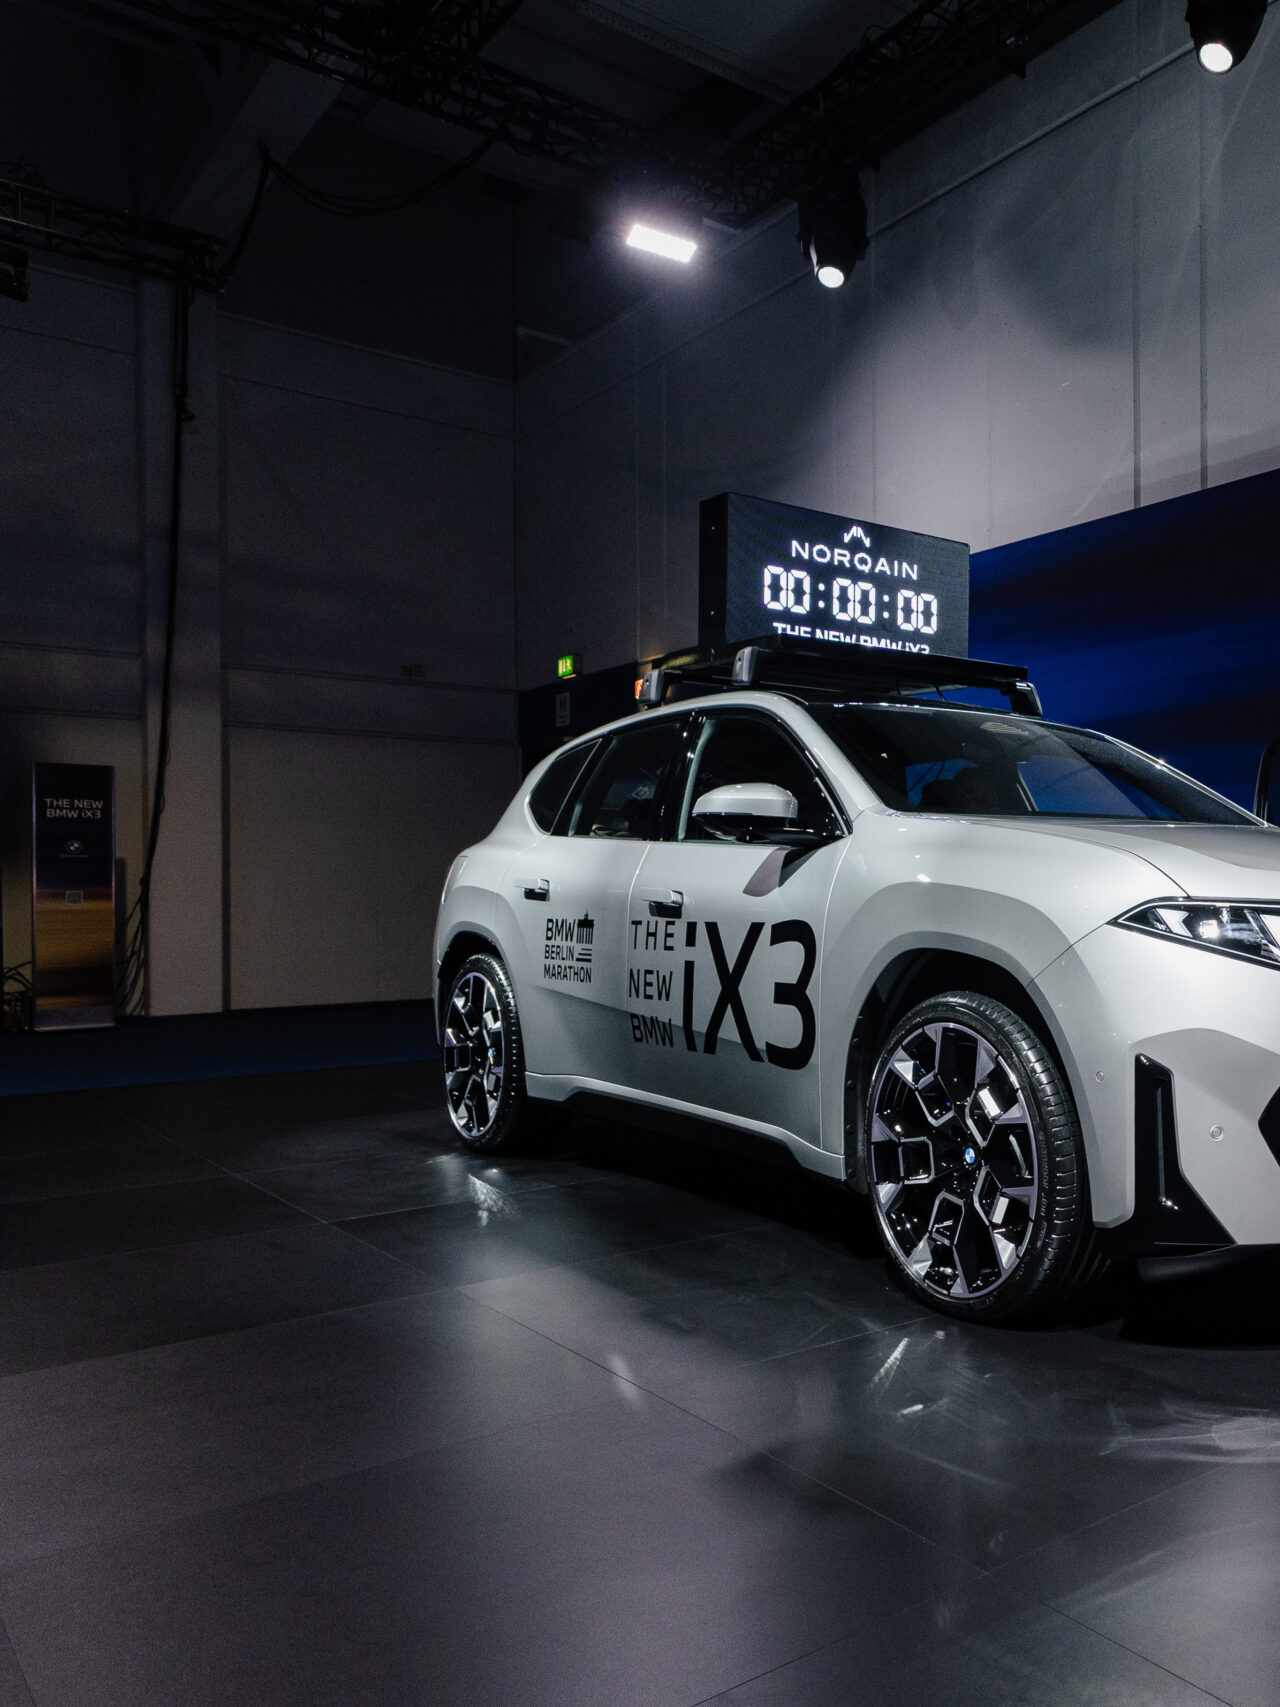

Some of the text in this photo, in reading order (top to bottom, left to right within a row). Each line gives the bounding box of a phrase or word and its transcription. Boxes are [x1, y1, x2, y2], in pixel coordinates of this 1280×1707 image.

[790, 540, 919, 580] NORQAIN
[763, 565, 938, 635] 00:00:00
[44, 798, 103, 809] THE NEW
[46, 809, 102, 819] BMW iX3
[545, 919, 577, 942] BMW
[631, 920, 676, 951] THE
[544, 945, 575, 962] BERLIN
[543, 964, 592, 983] MARATHON
[628, 969, 673, 1002] NEW
[683, 919, 817, 1070] iX3
[630, 1013, 674, 1048] BMW
